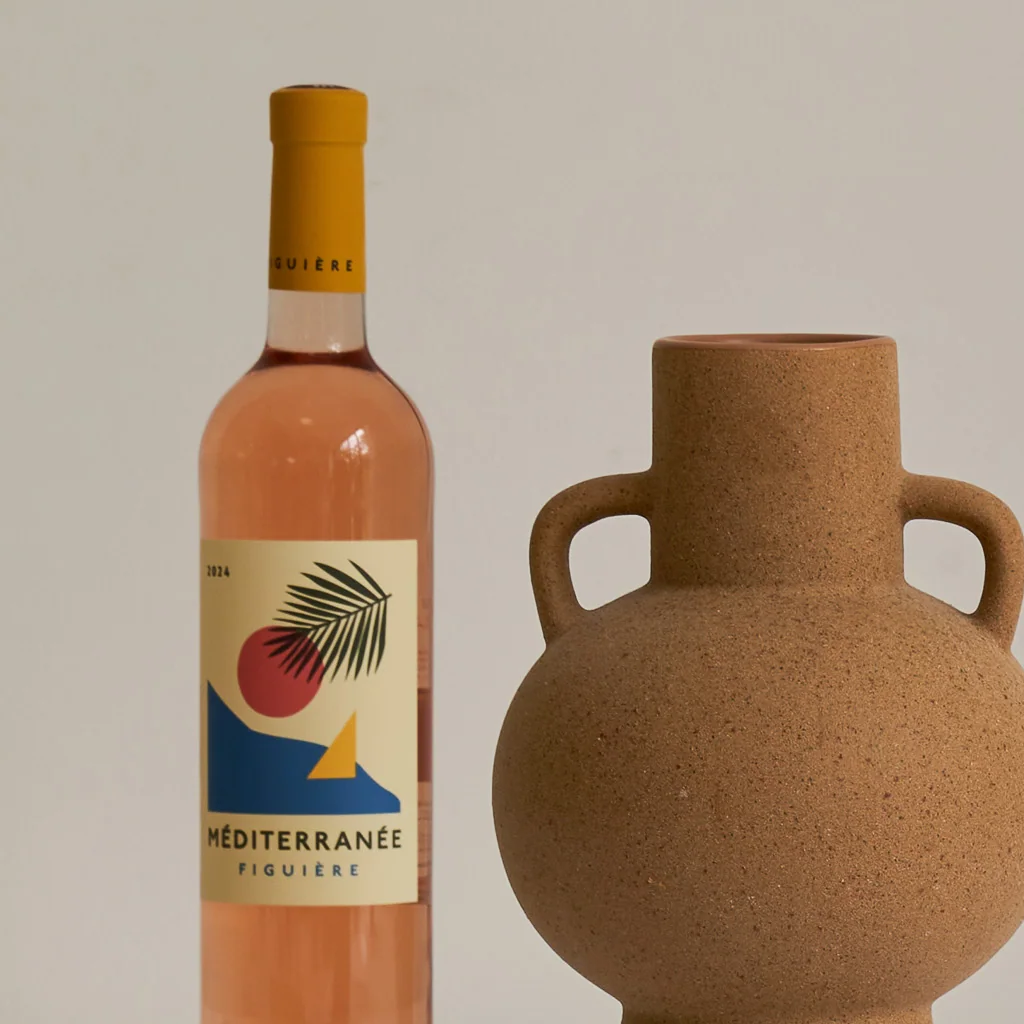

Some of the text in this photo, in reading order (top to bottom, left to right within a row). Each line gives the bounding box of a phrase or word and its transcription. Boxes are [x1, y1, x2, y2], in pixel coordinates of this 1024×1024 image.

[270, 256, 354, 272] GUIÈRE
[207, 565, 230, 578] 2024
[208, 824, 402, 852] MÉDITERRANÉE
[238, 861, 359, 877] FIGUIÈRE
